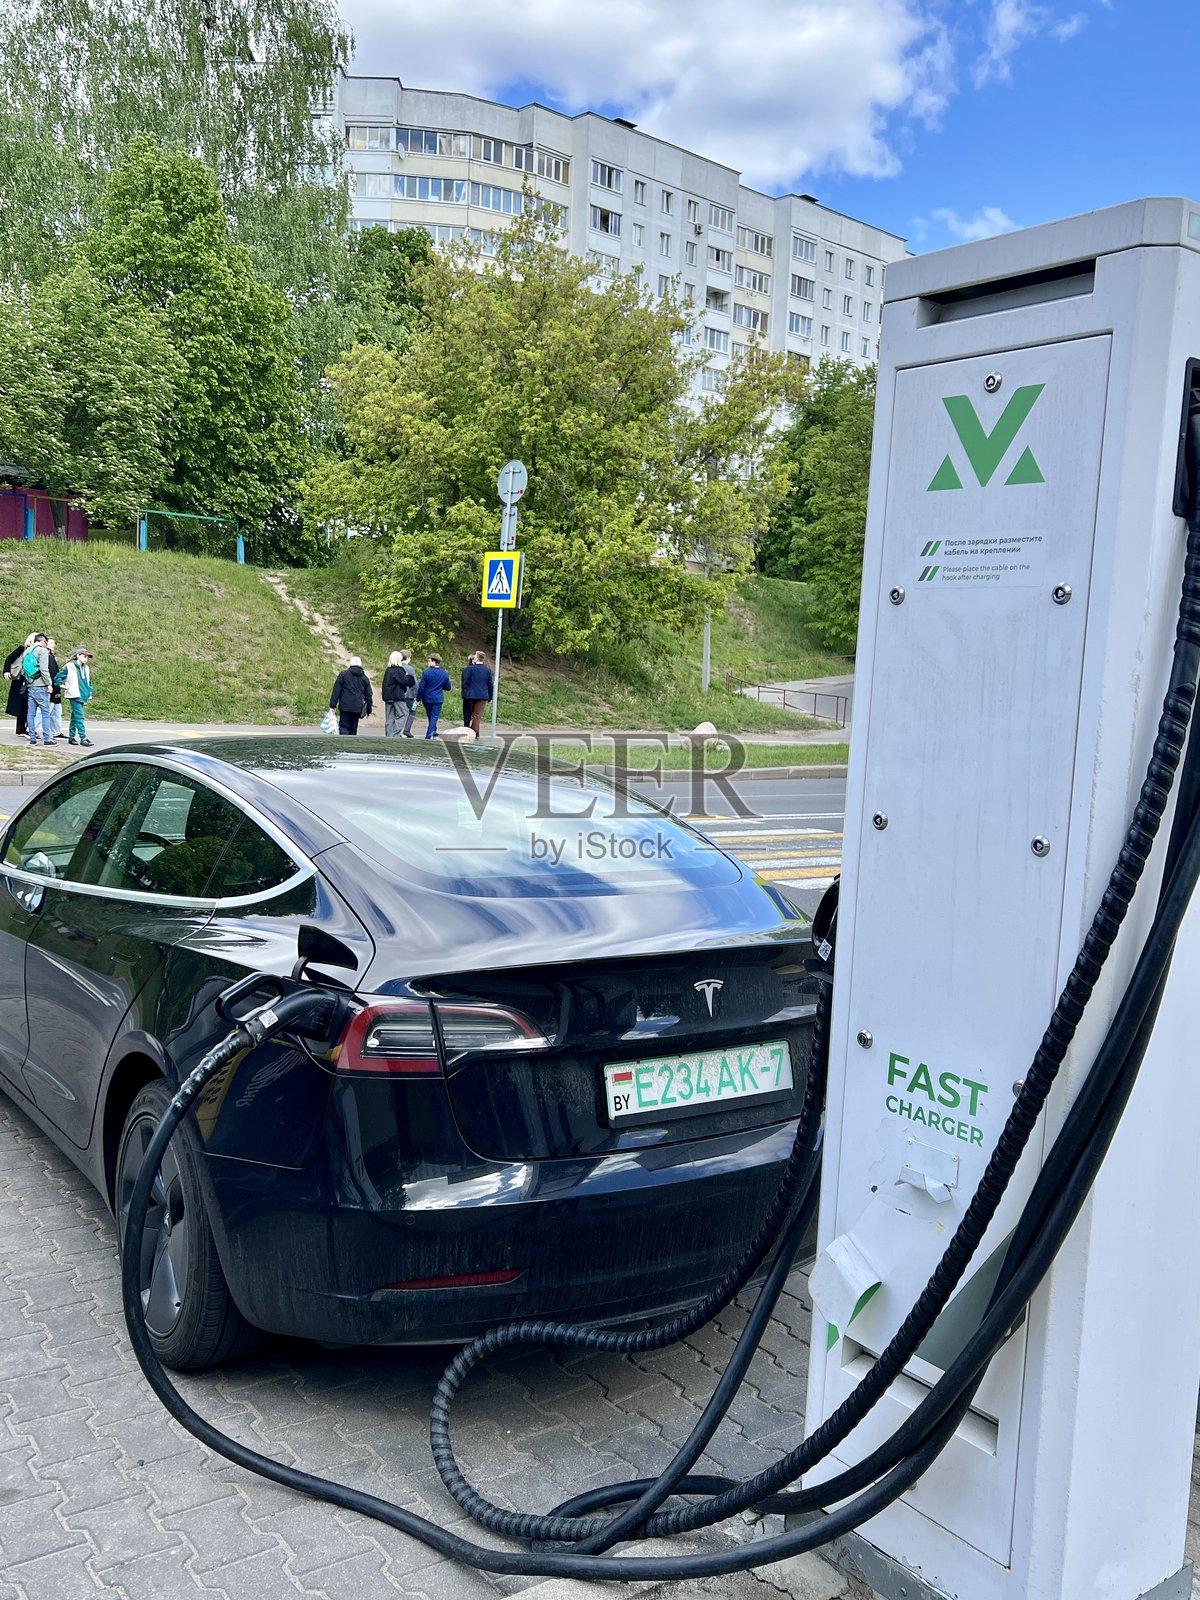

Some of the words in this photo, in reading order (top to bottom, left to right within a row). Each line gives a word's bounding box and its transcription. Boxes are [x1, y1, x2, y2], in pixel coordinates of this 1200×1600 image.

[968, 538, 998, 546] зарядки
[1000, 536, 1042, 545] разместите
[980, 547, 1021, 556] креплении
[973, 573, 1000, 581] charging
[887, 1052, 988, 1117] FAST
[613, 1094, 630, 1111] BY
[886, 1095, 984, 1148] CHARGER
